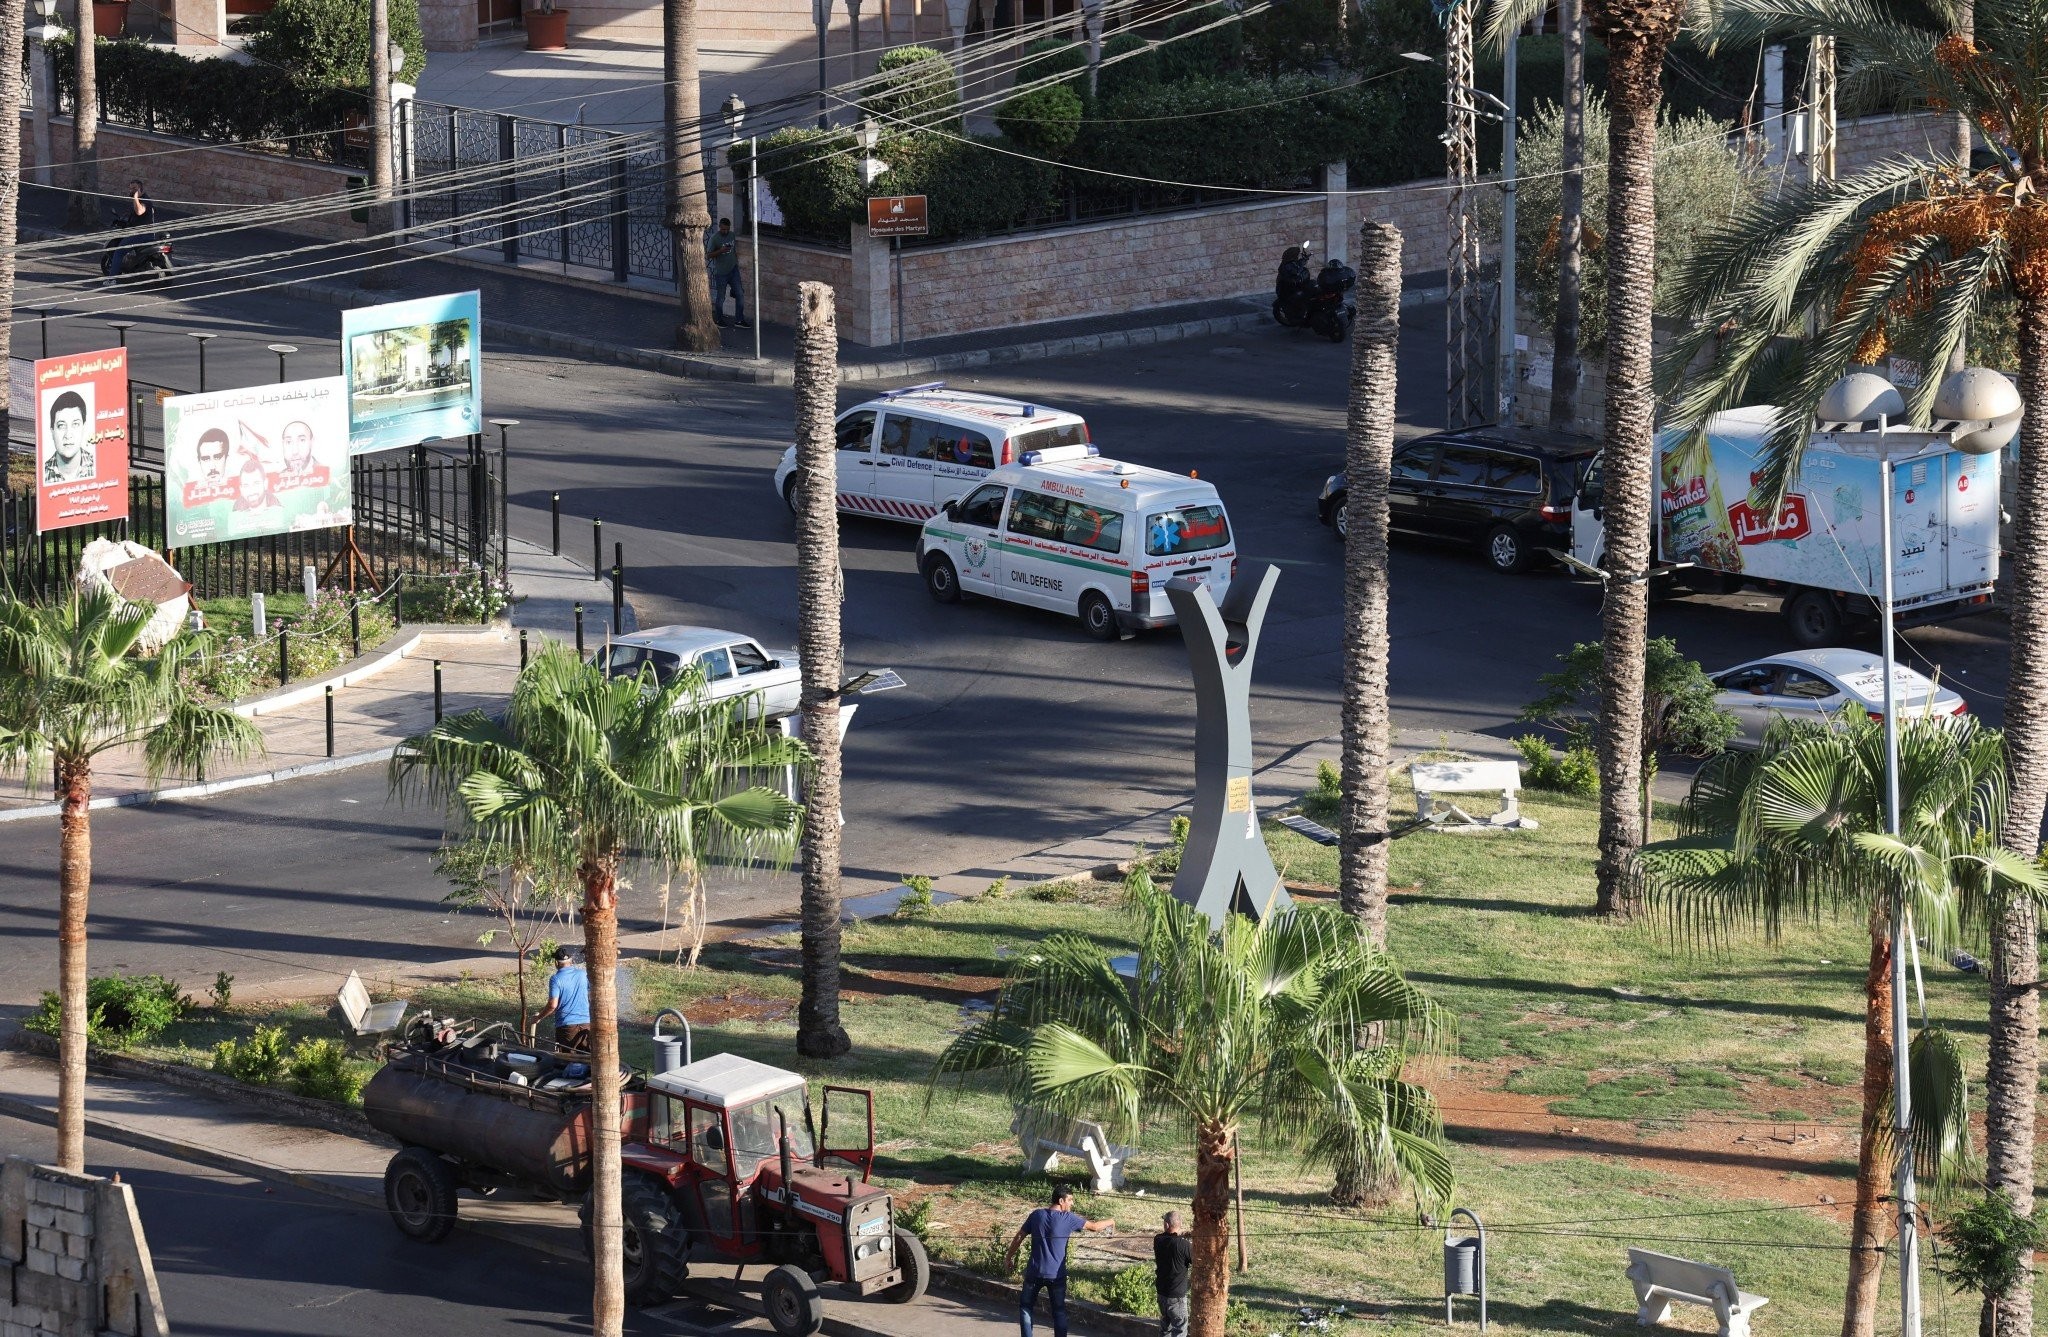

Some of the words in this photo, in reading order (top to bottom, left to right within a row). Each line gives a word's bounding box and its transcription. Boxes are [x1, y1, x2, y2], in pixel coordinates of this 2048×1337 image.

[64, 357, 102, 381] الديمقراطي
[102, 354, 123, 372] الحزب
[40, 364, 64, 385] الشعبي
[223, 394, 256, 408] حتى
[259, 393, 280, 406] جيل
[282, 389, 308, 402] يخلف
[310, 387, 330, 400] جيل
[183, 399, 219, 416] التحرير
[104, 424, 125, 442] رشيد
[891, 457, 906, 468] Civil
[906, 459, 933, 471] Defence
[1041, 479, 1085, 498] AMBULANCE
[1958, 478, 1969, 489] AB
[1662, 487, 1706, 513] Mumtaz
[1905, 492, 1915, 502] AB
[1673, 510, 1688, 523] GOLD
[1688, 505, 1702, 515] RICE
[1010, 570, 1029, 585] CIVIL
[1030, 574, 1063, 592] DEFENSE
[826, 1212, 840, 1222] 290
